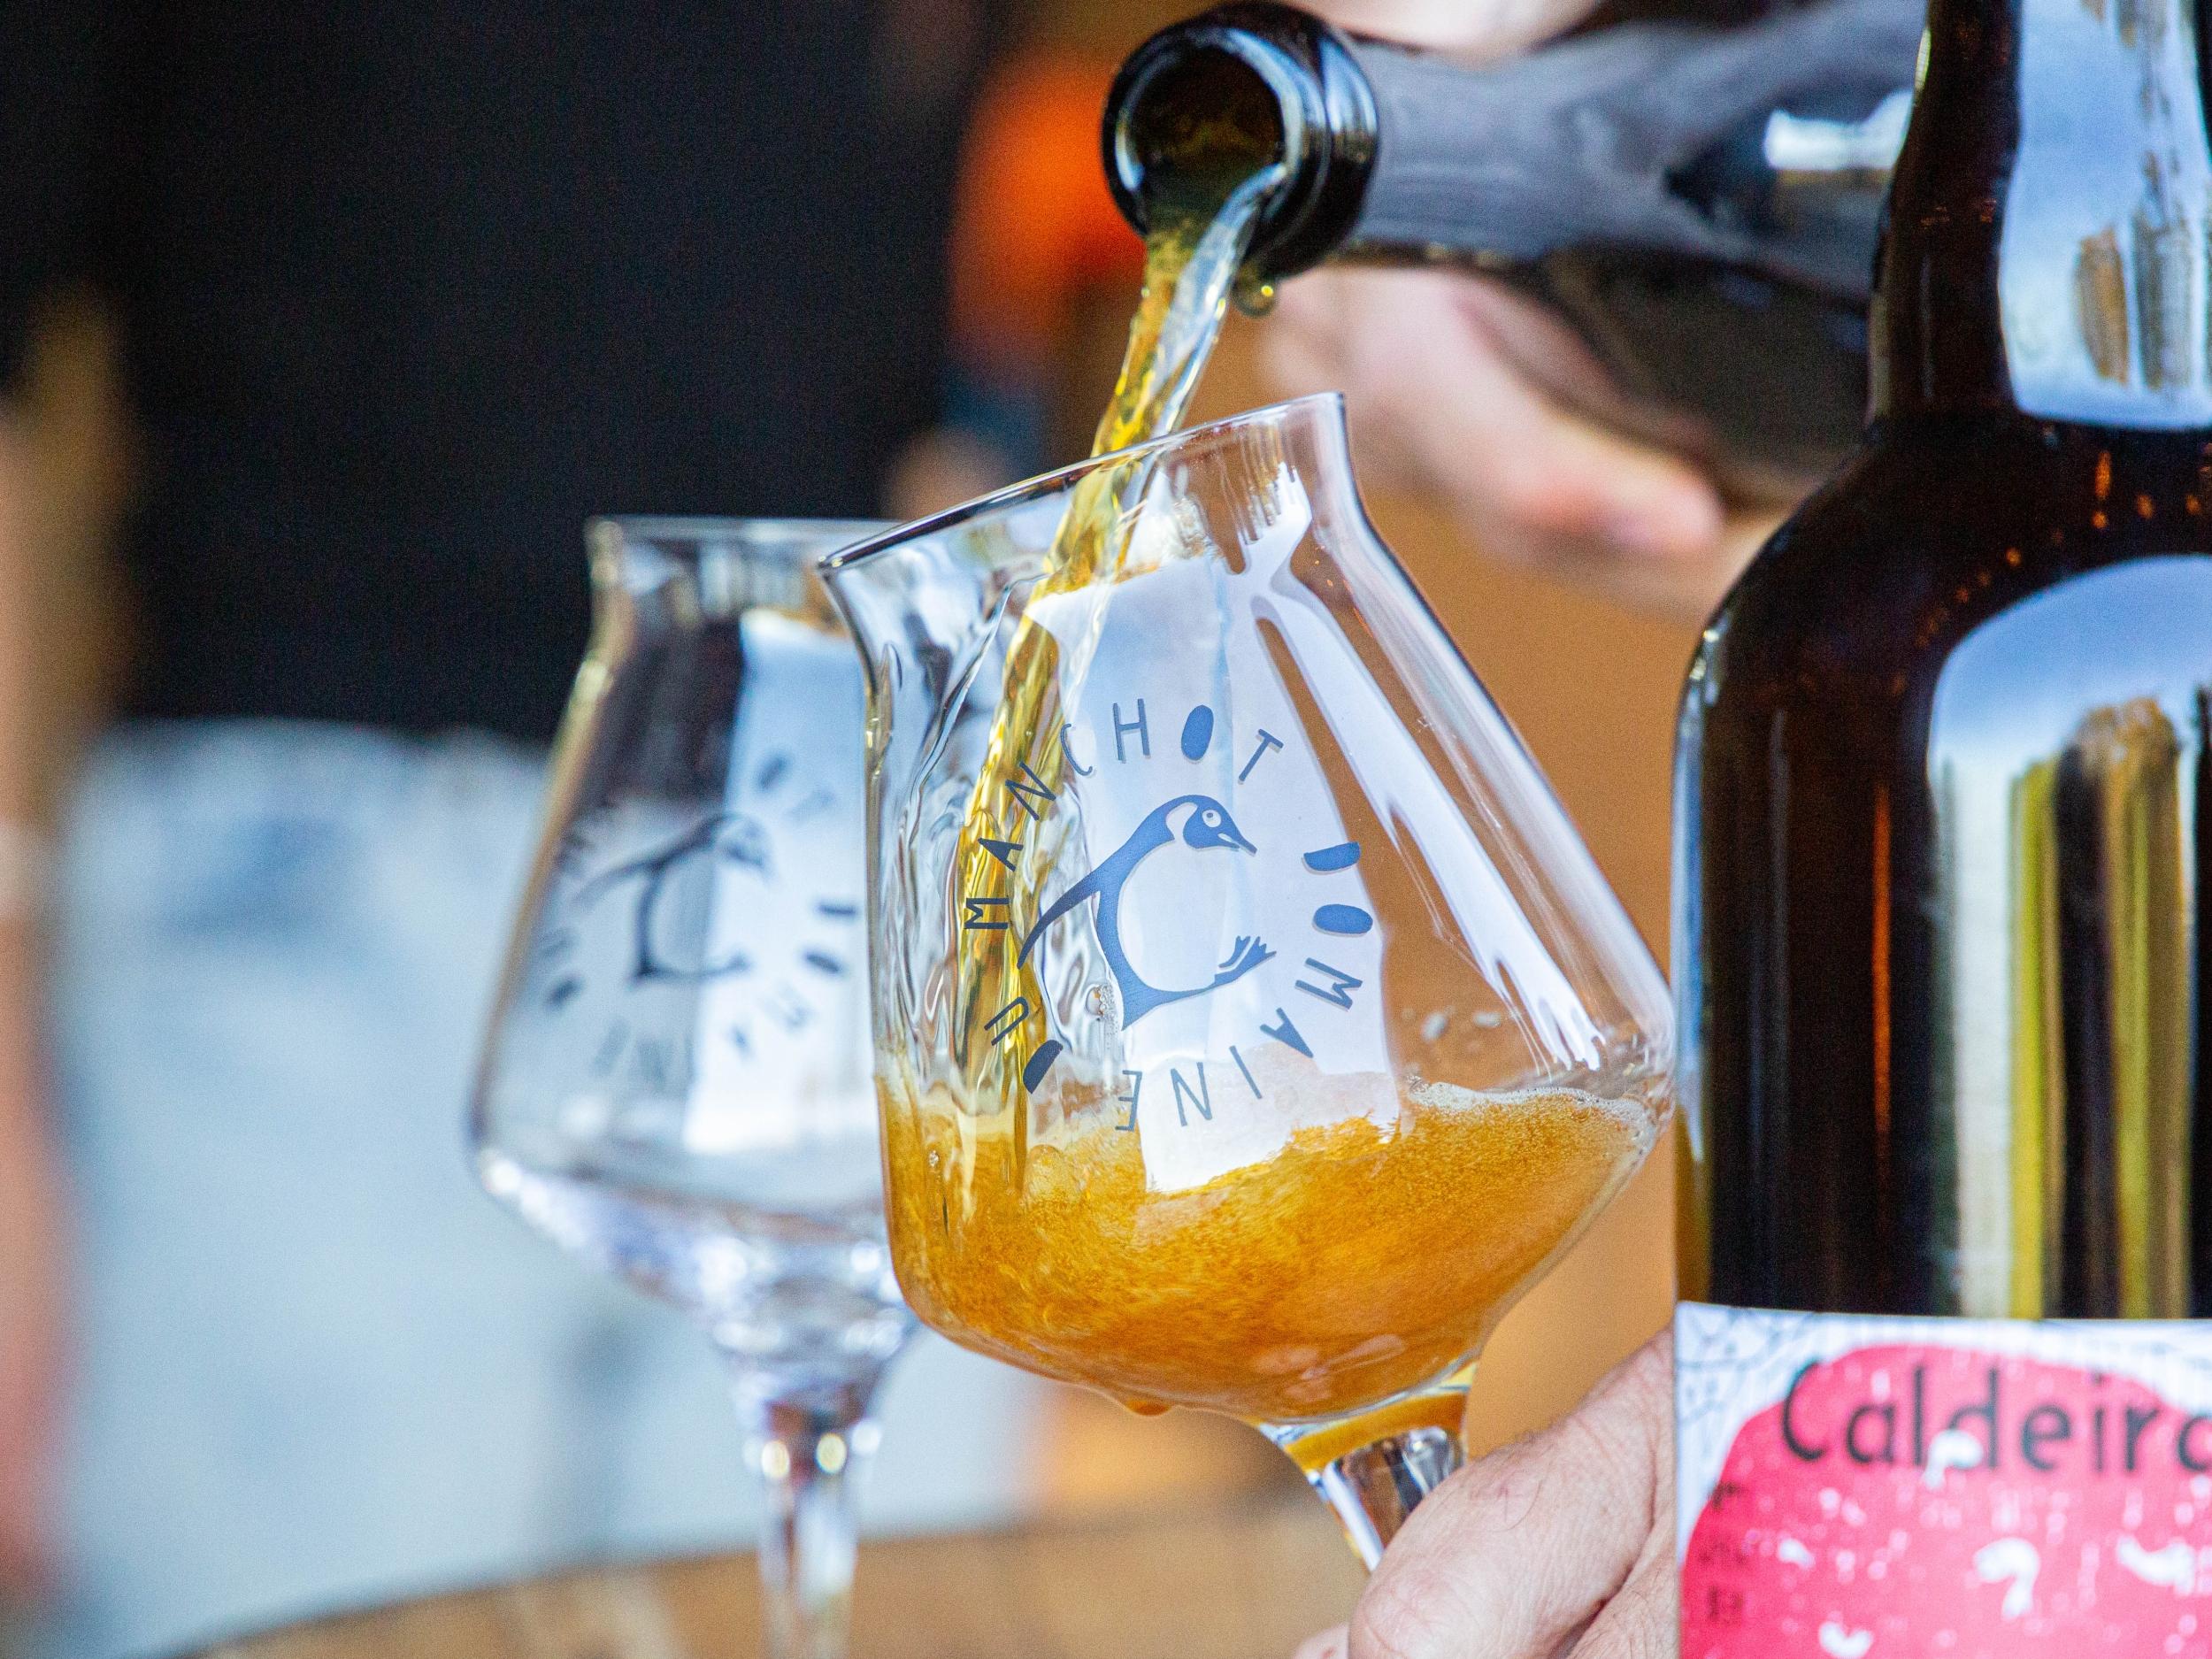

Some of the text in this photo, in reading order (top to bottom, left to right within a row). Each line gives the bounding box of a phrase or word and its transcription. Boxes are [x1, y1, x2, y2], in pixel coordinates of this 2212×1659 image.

[964, 699, 1373, 1132] DOMAINE DU MANCHOT
